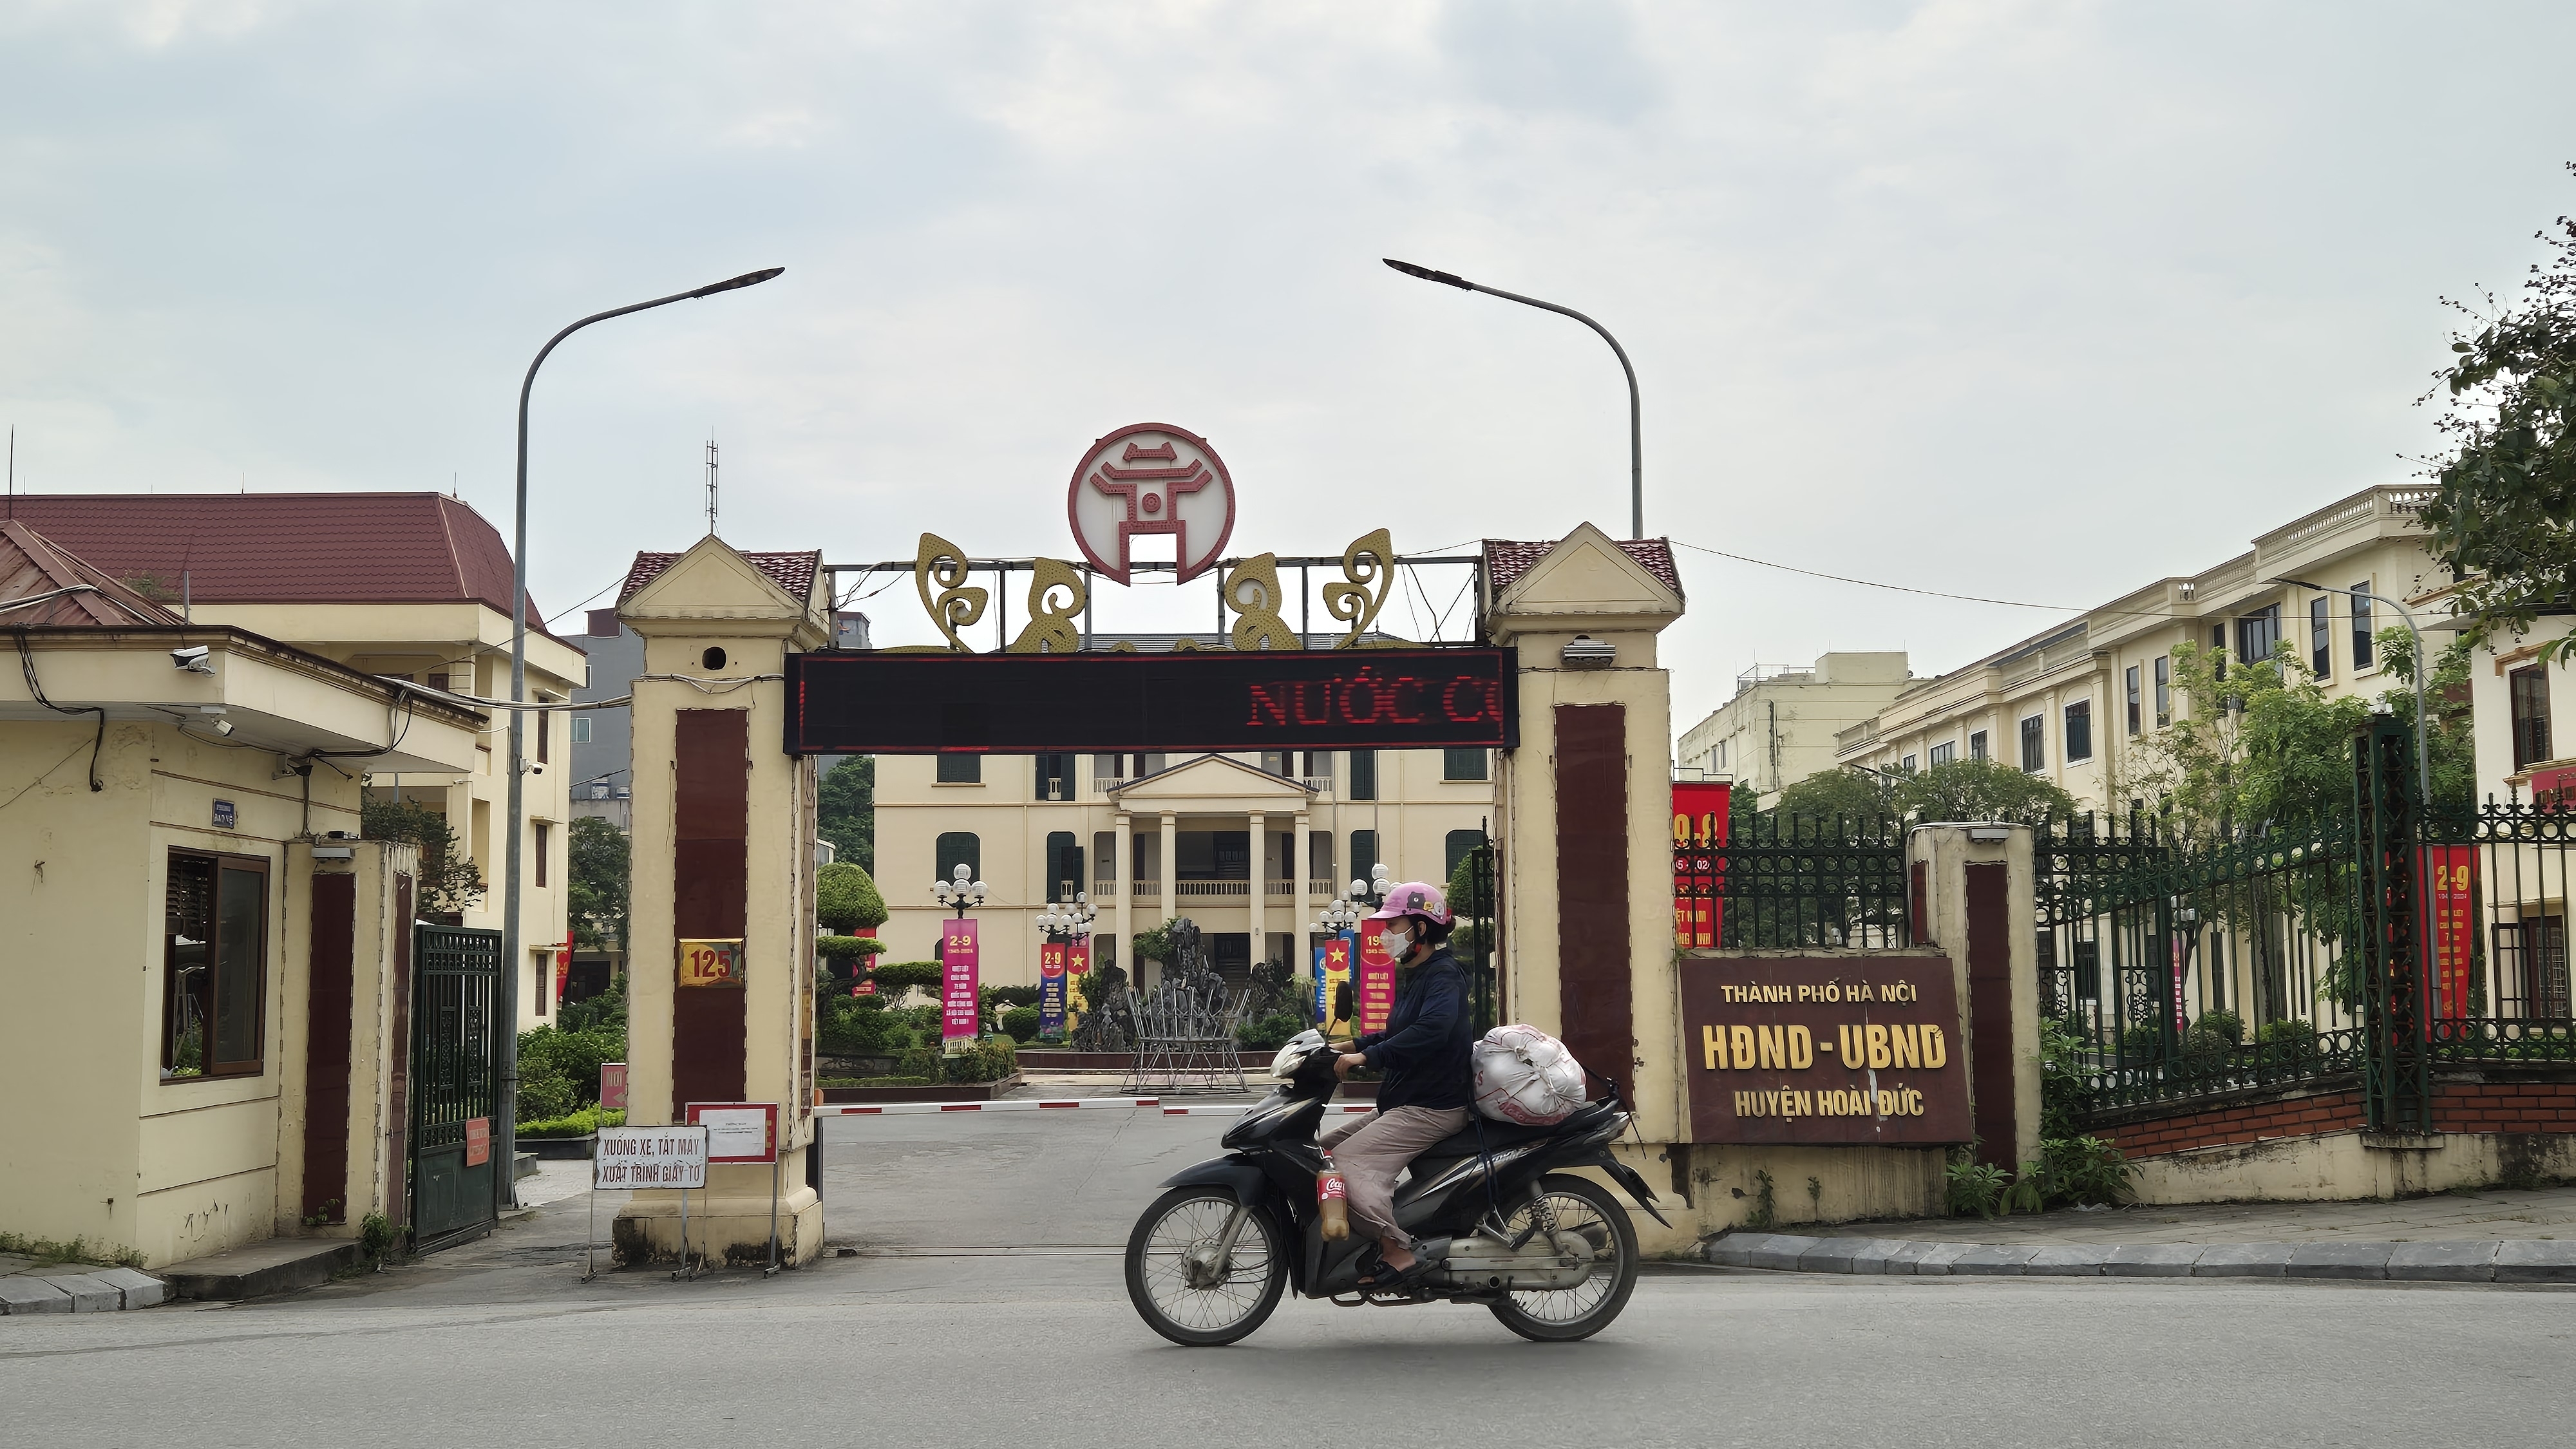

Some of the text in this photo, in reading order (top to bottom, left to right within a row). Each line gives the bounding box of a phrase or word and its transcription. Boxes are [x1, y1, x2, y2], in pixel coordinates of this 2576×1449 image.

[1247, 666, 1425, 725] NƯỚC
[2438, 866, 2468, 891] 2-9
[950, 935, 971, 946] 2-9
[691, 949, 731, 977] 125
[1045, 952, 1061, 964] 2-9
[1721, 977, 1917, 1006] THÀNH PHỐ HÀ NỘI
[1702, 1025, 1814, 1069] HĐND
[1838, 1024, 1947, 1069] UBND
[1734, 1082, 1924, 1122] HUYỆN HOÀI ĐỨC
[604, 1132, 699, 1157] XUỐNG XE, TẮT MÁY
